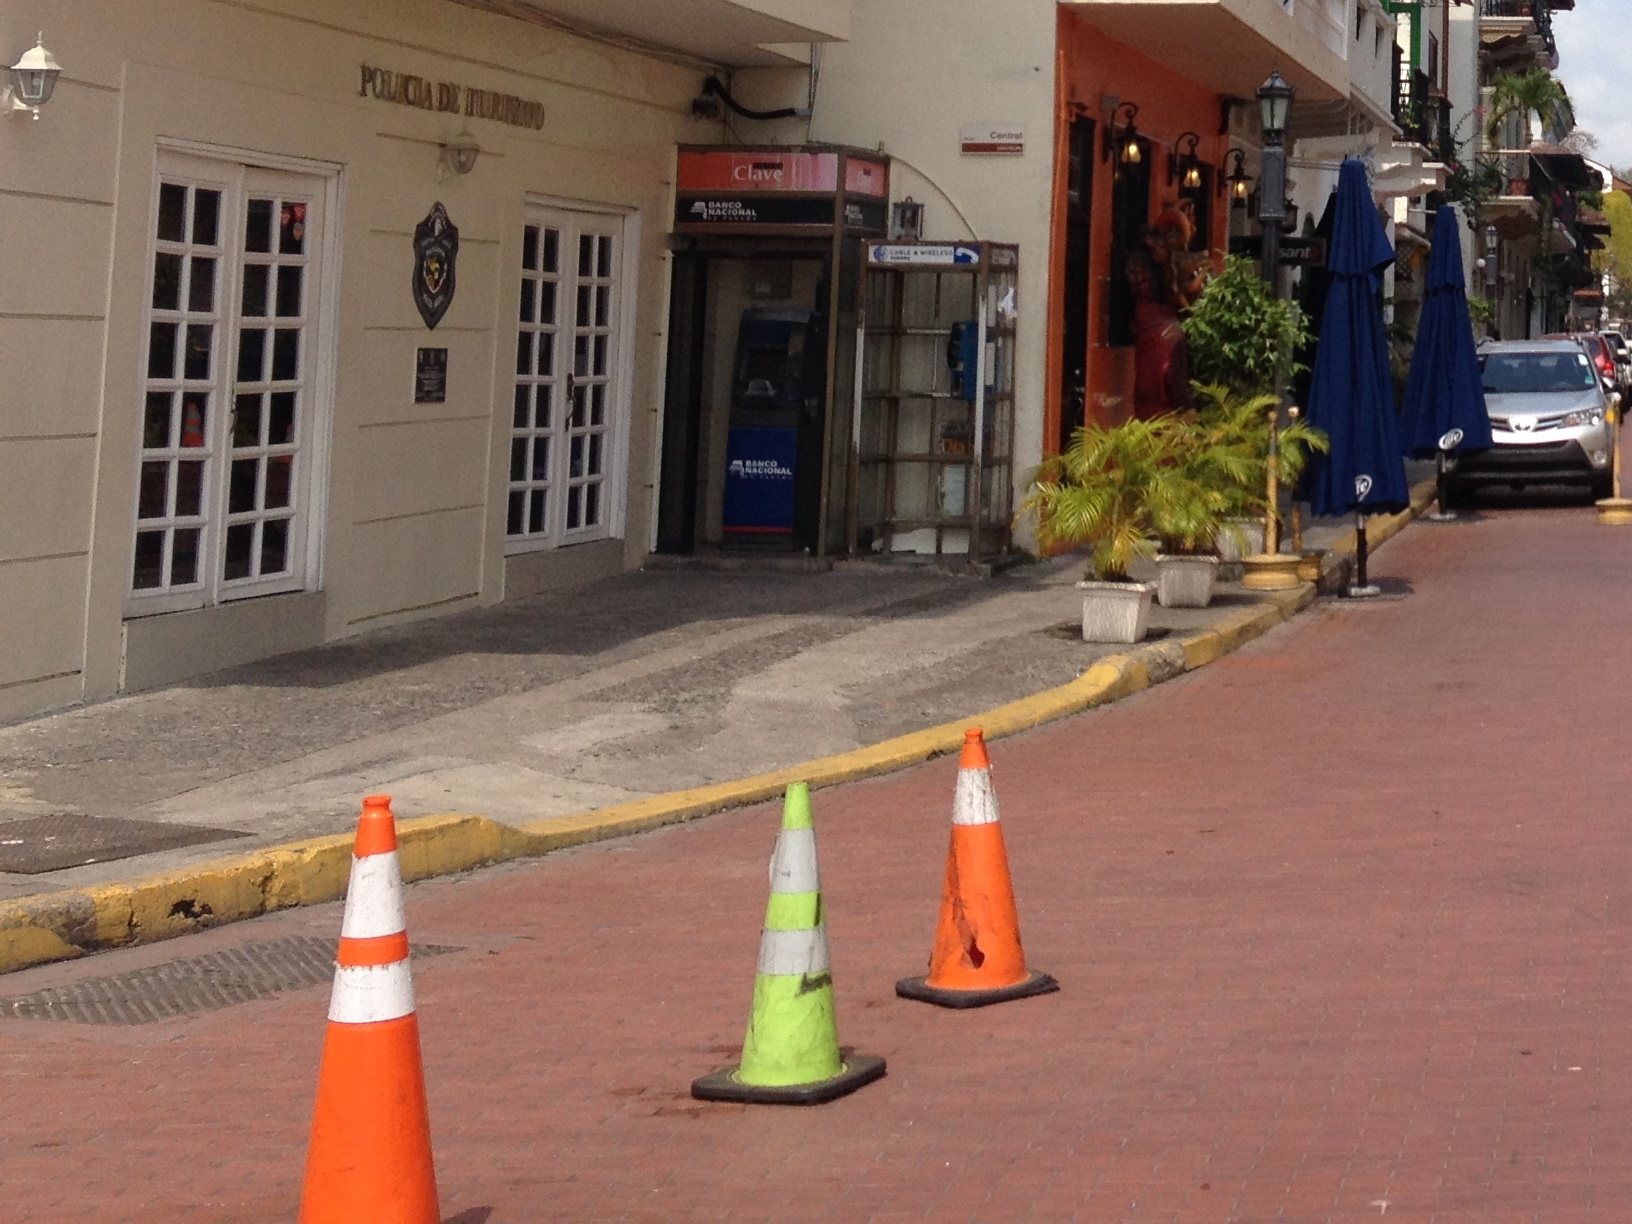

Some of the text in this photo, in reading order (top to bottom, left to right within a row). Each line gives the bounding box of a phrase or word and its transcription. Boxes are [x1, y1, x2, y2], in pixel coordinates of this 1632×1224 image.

[436, 82, 460, 114] DE
[990, 131, 1023, 140] Central
[734, 164, 784, 181] Clave
[708, 201, 742, 209] BANCO
[708, 208, 757, 216] NACIONAL
[745, 460, 778, 468] BANCO
[745, 467, 792, 475] NACIONAL
